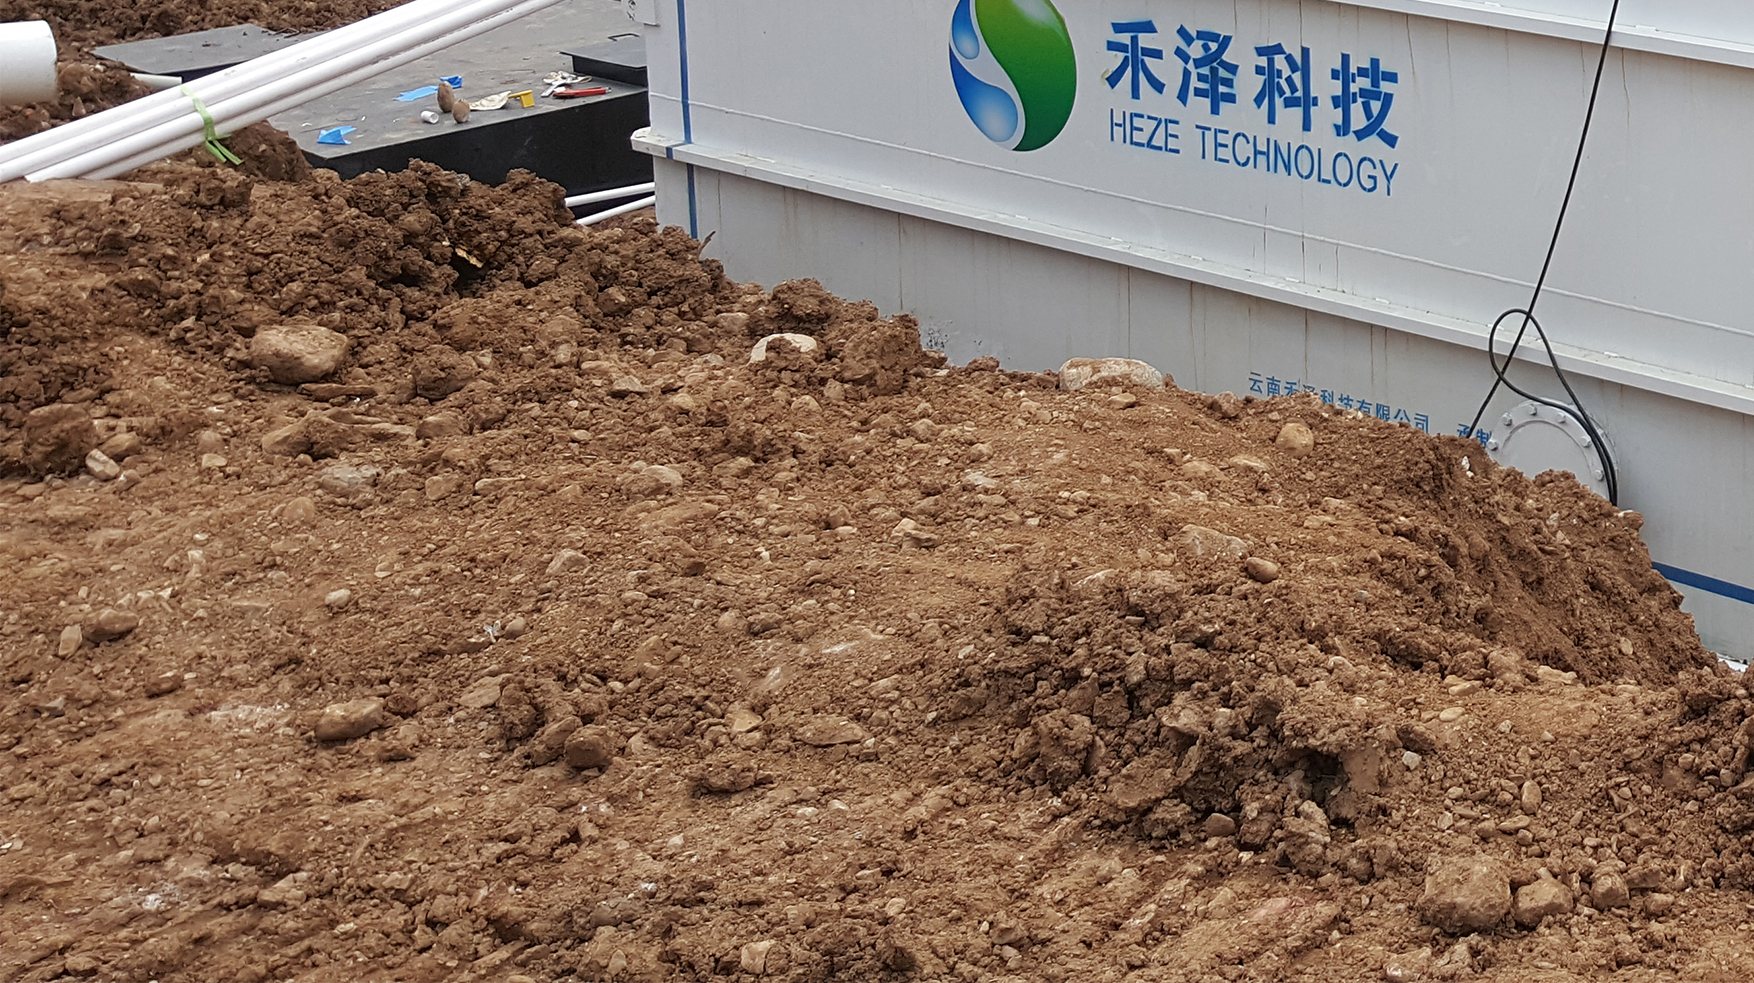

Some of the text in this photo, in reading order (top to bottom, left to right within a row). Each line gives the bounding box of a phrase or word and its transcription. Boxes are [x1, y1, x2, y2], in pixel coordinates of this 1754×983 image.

[1104, 19, 1399, 149] 禾泽科技
[1109, 107, 1400, 197] HEZE TECHNOLOGY
